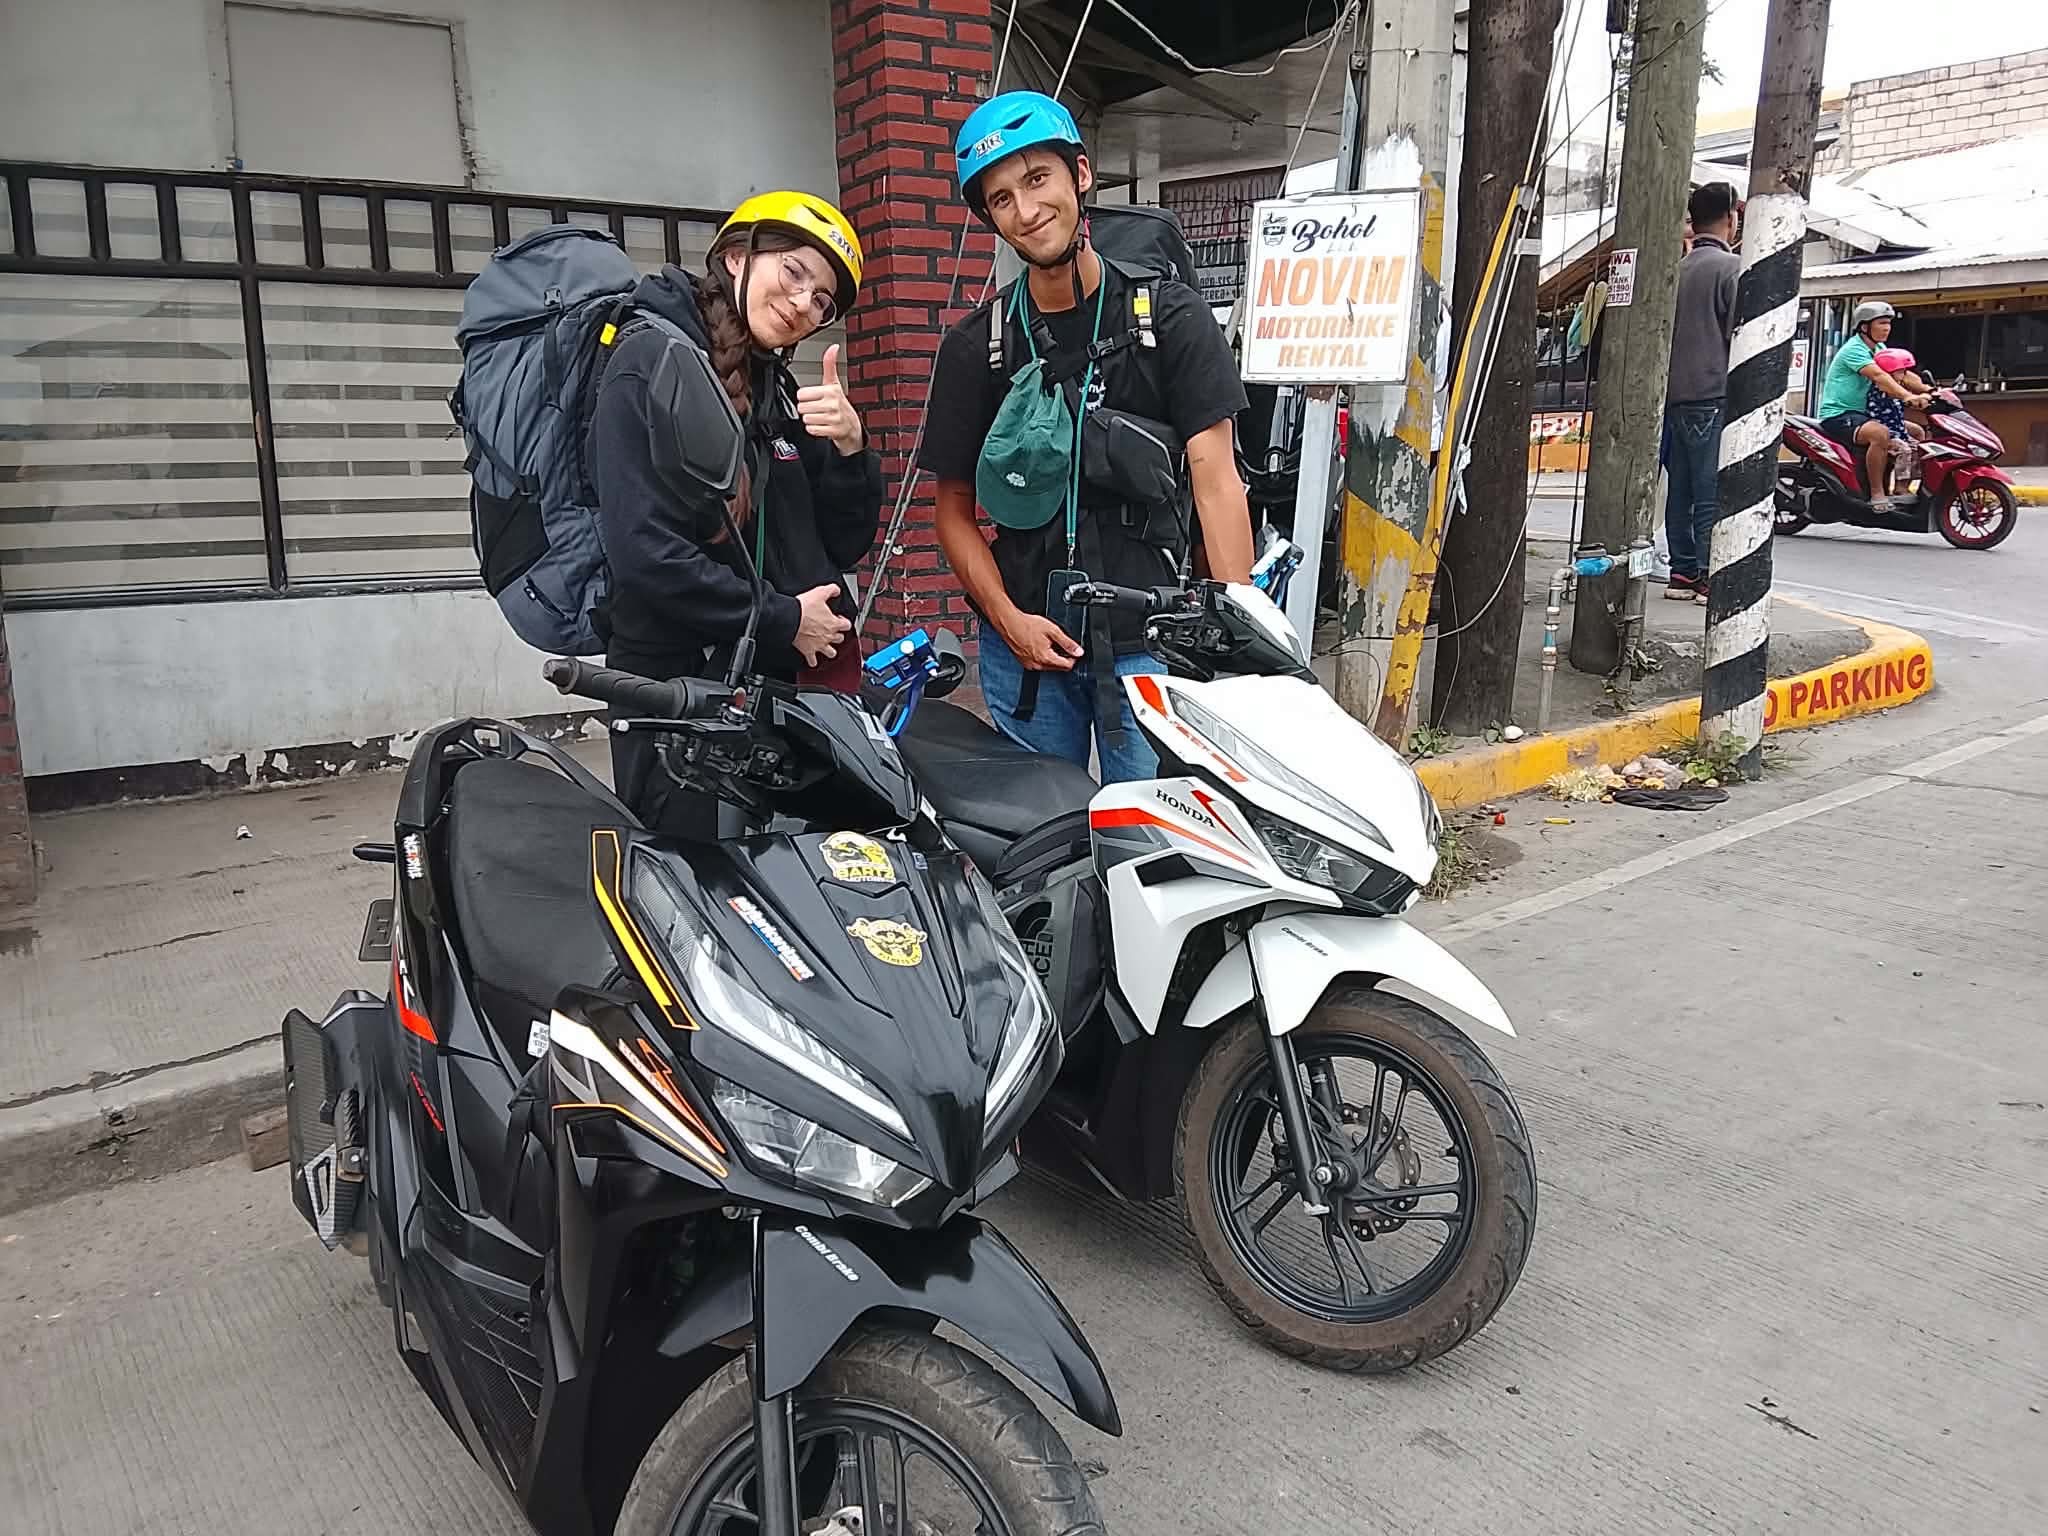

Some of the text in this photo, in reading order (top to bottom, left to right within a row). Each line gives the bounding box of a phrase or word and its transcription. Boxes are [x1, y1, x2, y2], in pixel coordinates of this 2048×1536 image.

[1291, 214, 1377, 252] Bohol
[1256, 256, 1406, 306] NOVIM
[1256, 315, 1398, 339] MOTORBIKE
[1277, 343, 1368, 368] RENTAL
[1764, 654, 1926, 727] O PARKING
[1156, 788, 1216, 829] HONDA
[825, 1253, 859, 1280] Brake
